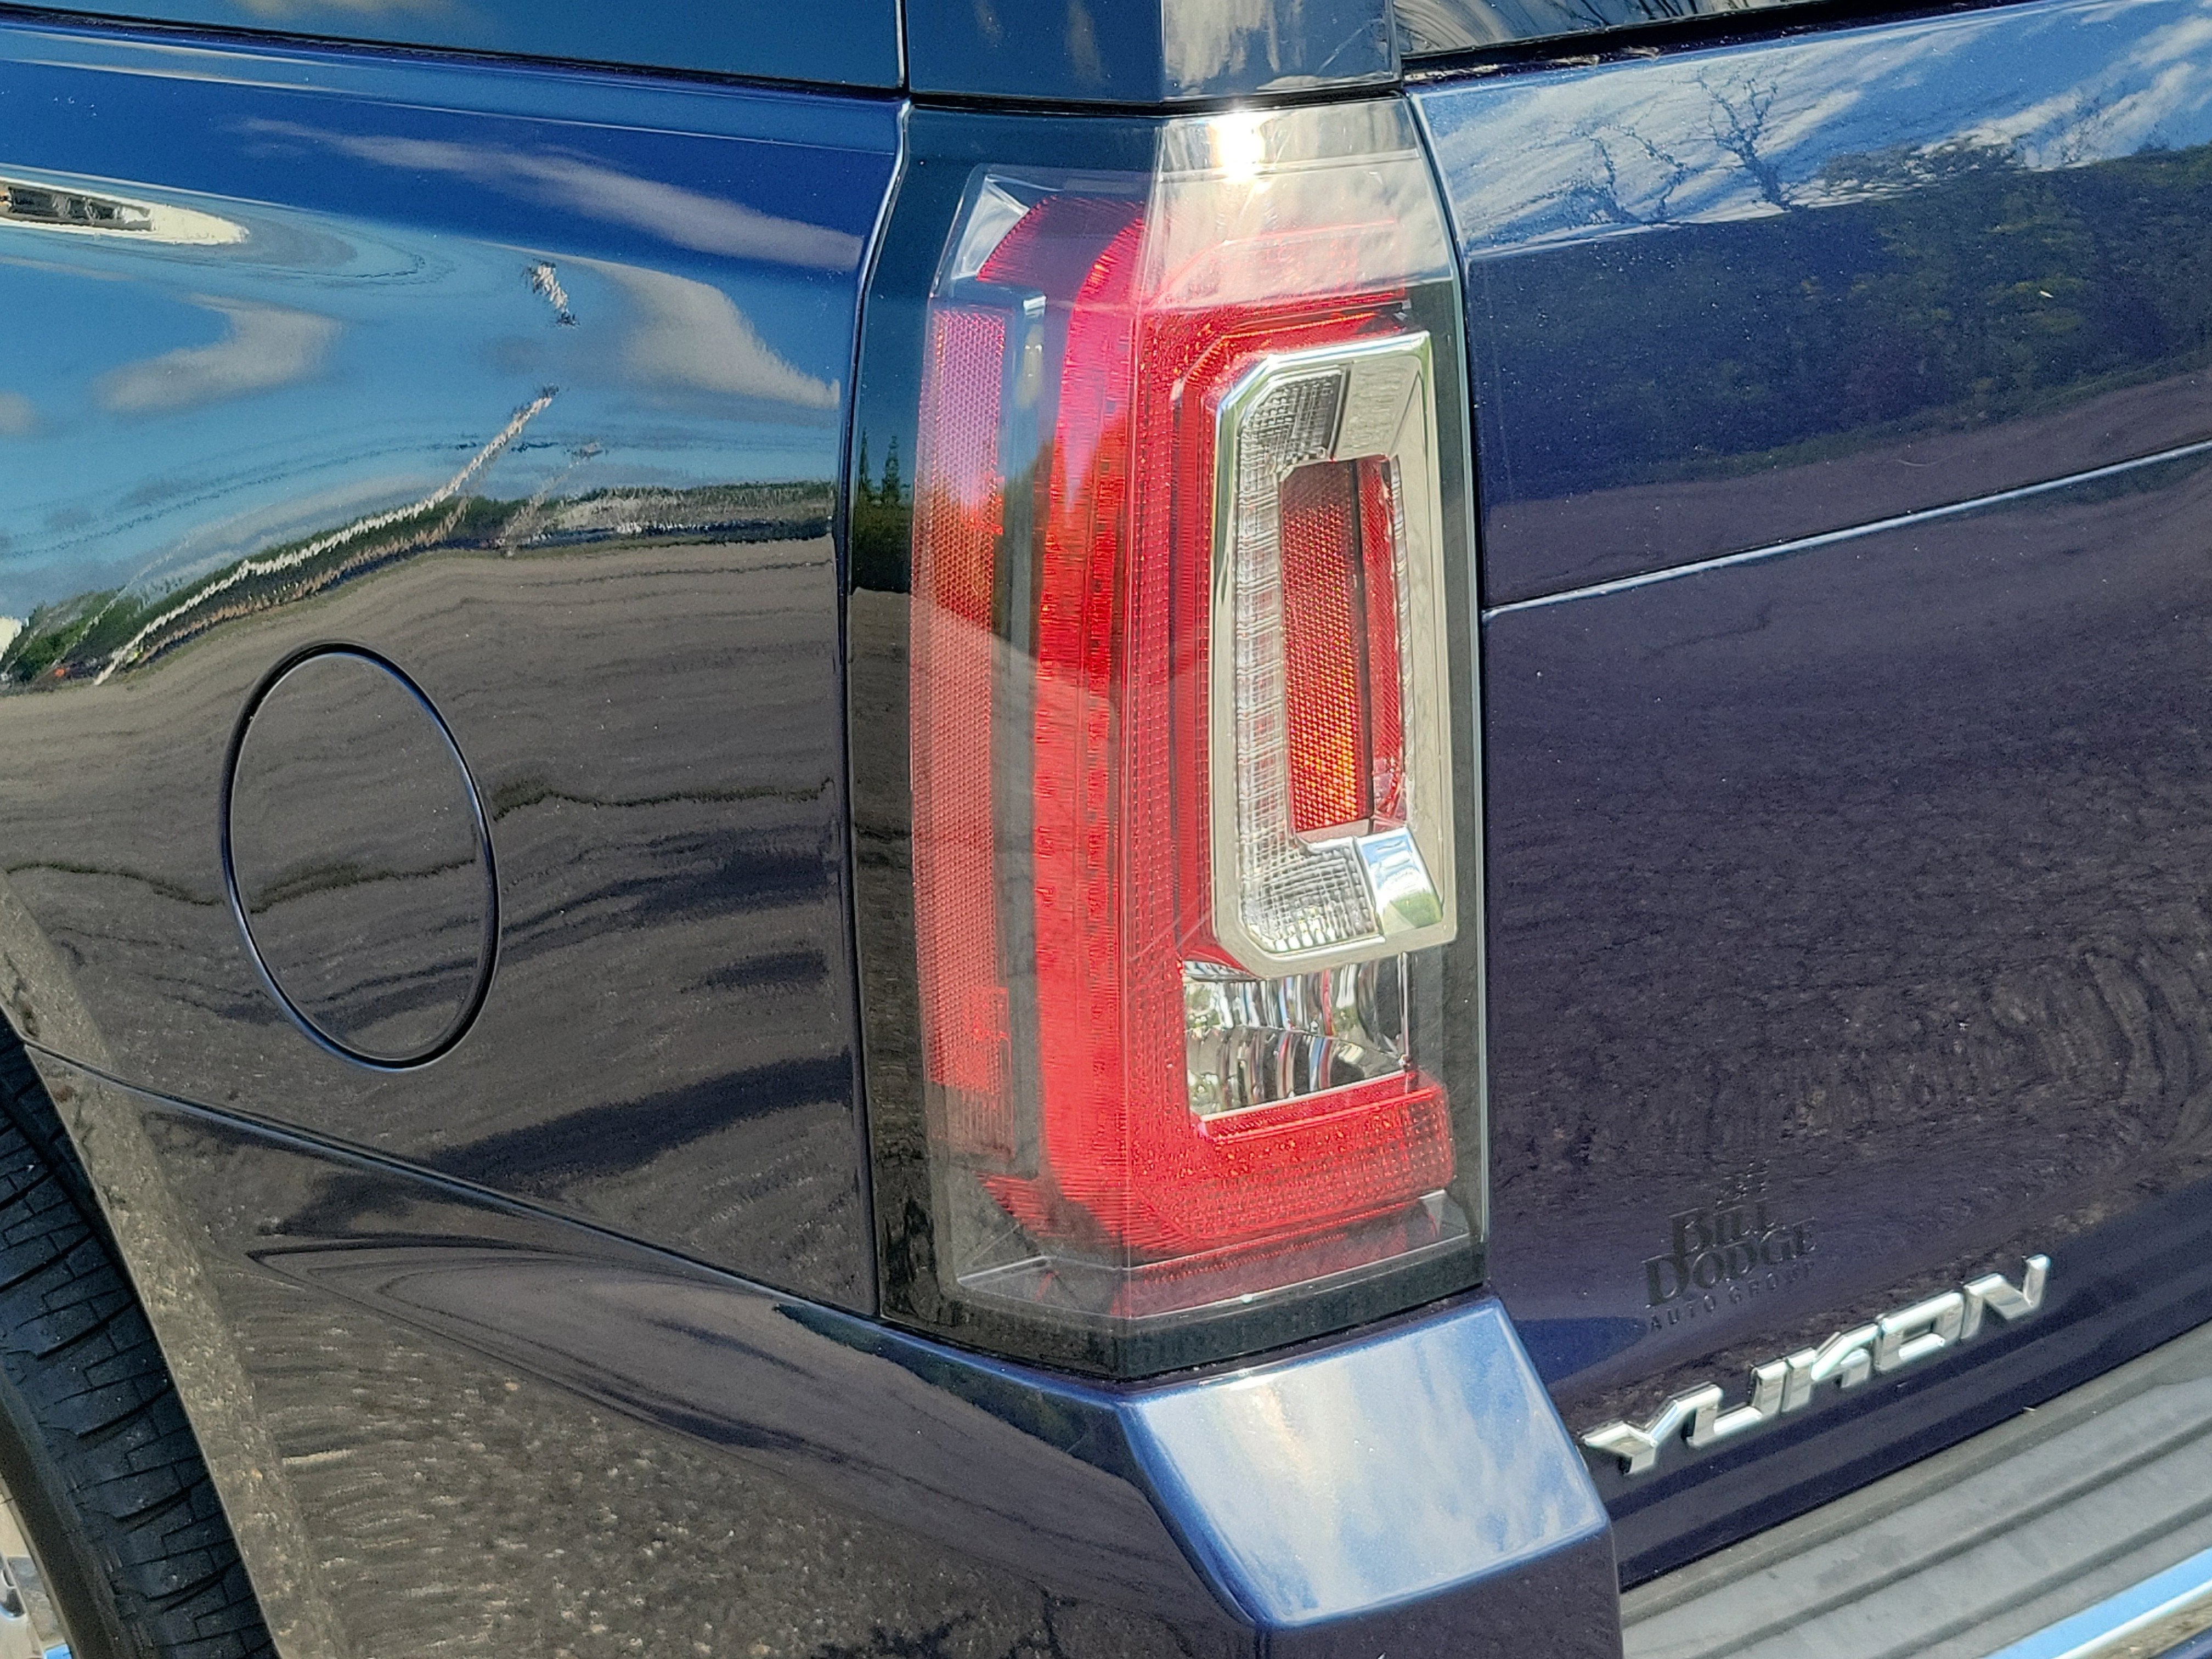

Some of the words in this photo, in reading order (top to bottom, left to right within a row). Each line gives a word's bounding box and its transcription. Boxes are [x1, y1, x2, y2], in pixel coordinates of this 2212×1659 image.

[1641, 1218, 1820, 1307] DODGE
[1651, 1295, 1716, 1333] AUTO
[1582, 1254, 2051, 1475] YUKON
